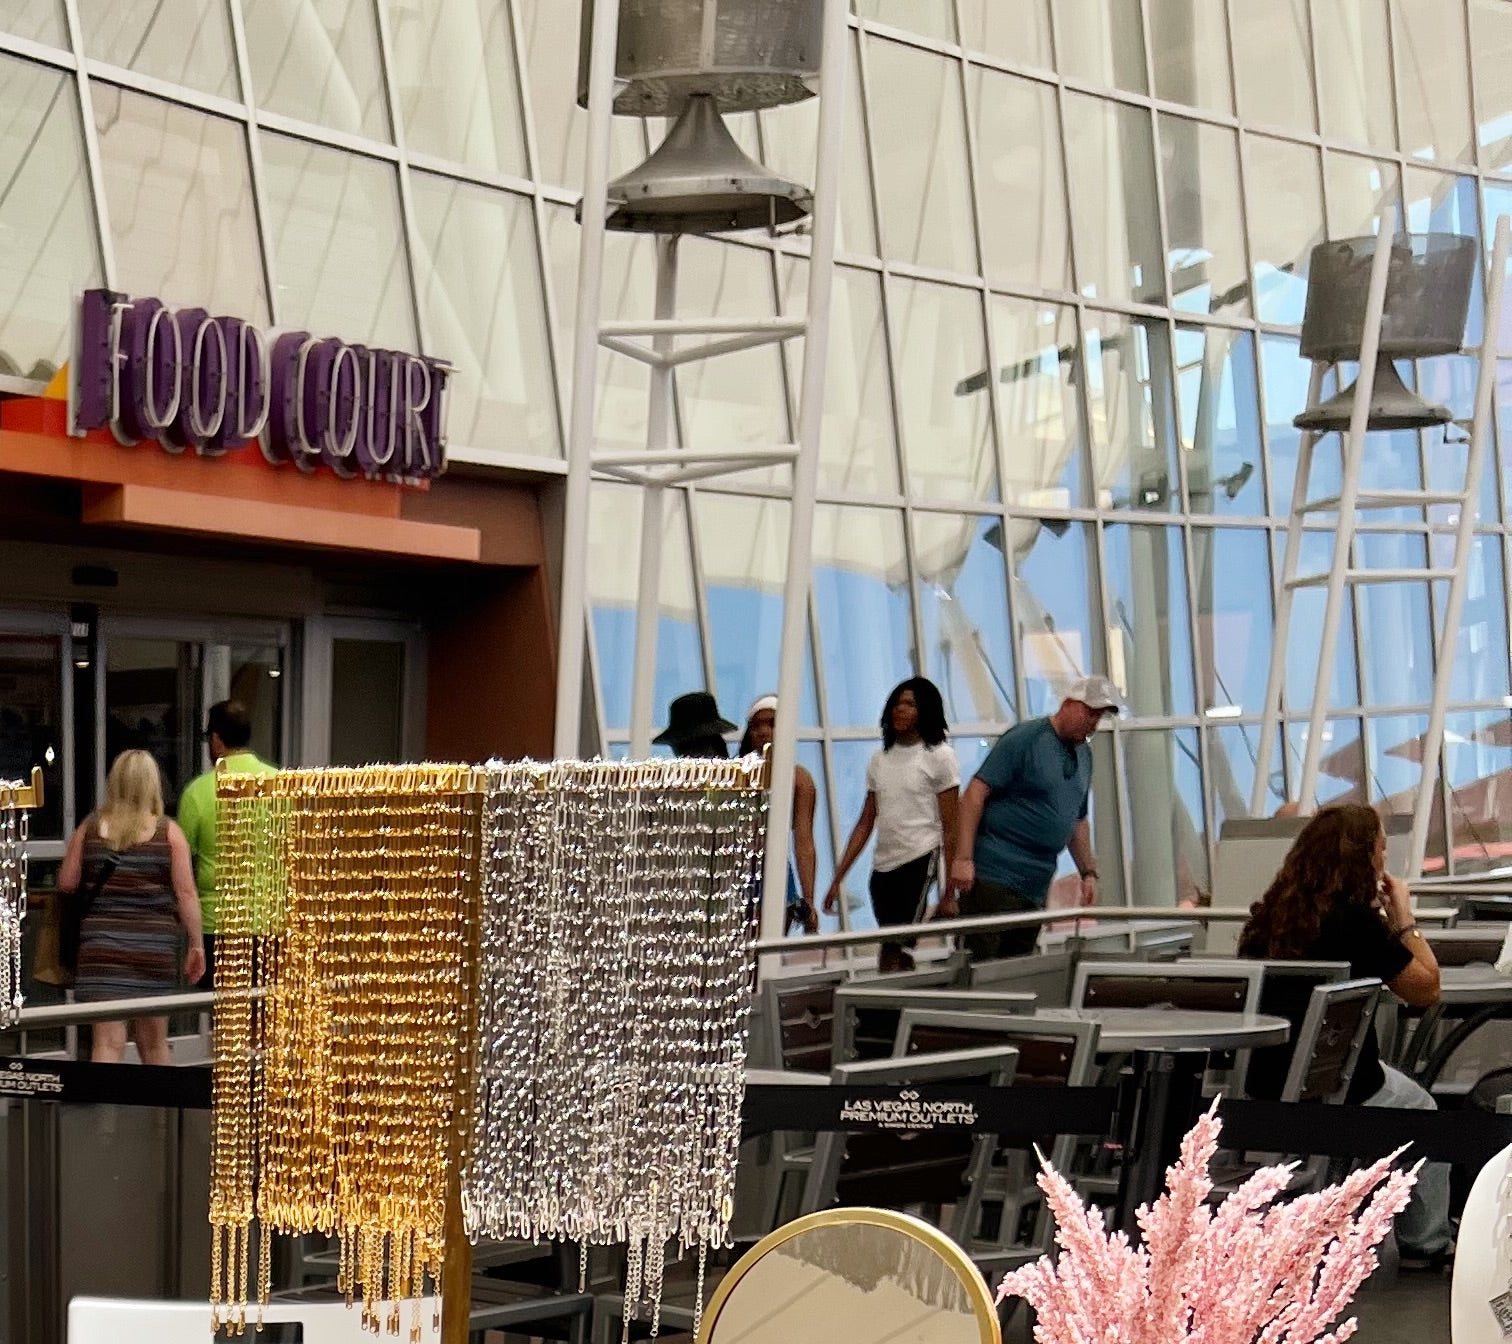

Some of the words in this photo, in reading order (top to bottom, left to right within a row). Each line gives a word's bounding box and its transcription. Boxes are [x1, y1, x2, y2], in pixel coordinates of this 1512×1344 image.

[68, 289, 272, 455] FOOD
[258, 331, 461, 482] COURT
[844, 1100, 872, 1111] LAS
[873, 1101, 921, 1113] VEGAS
[922, 1101, 974, 1114] NORTH
[840, 1110, 907, 1122] PREMIUM
